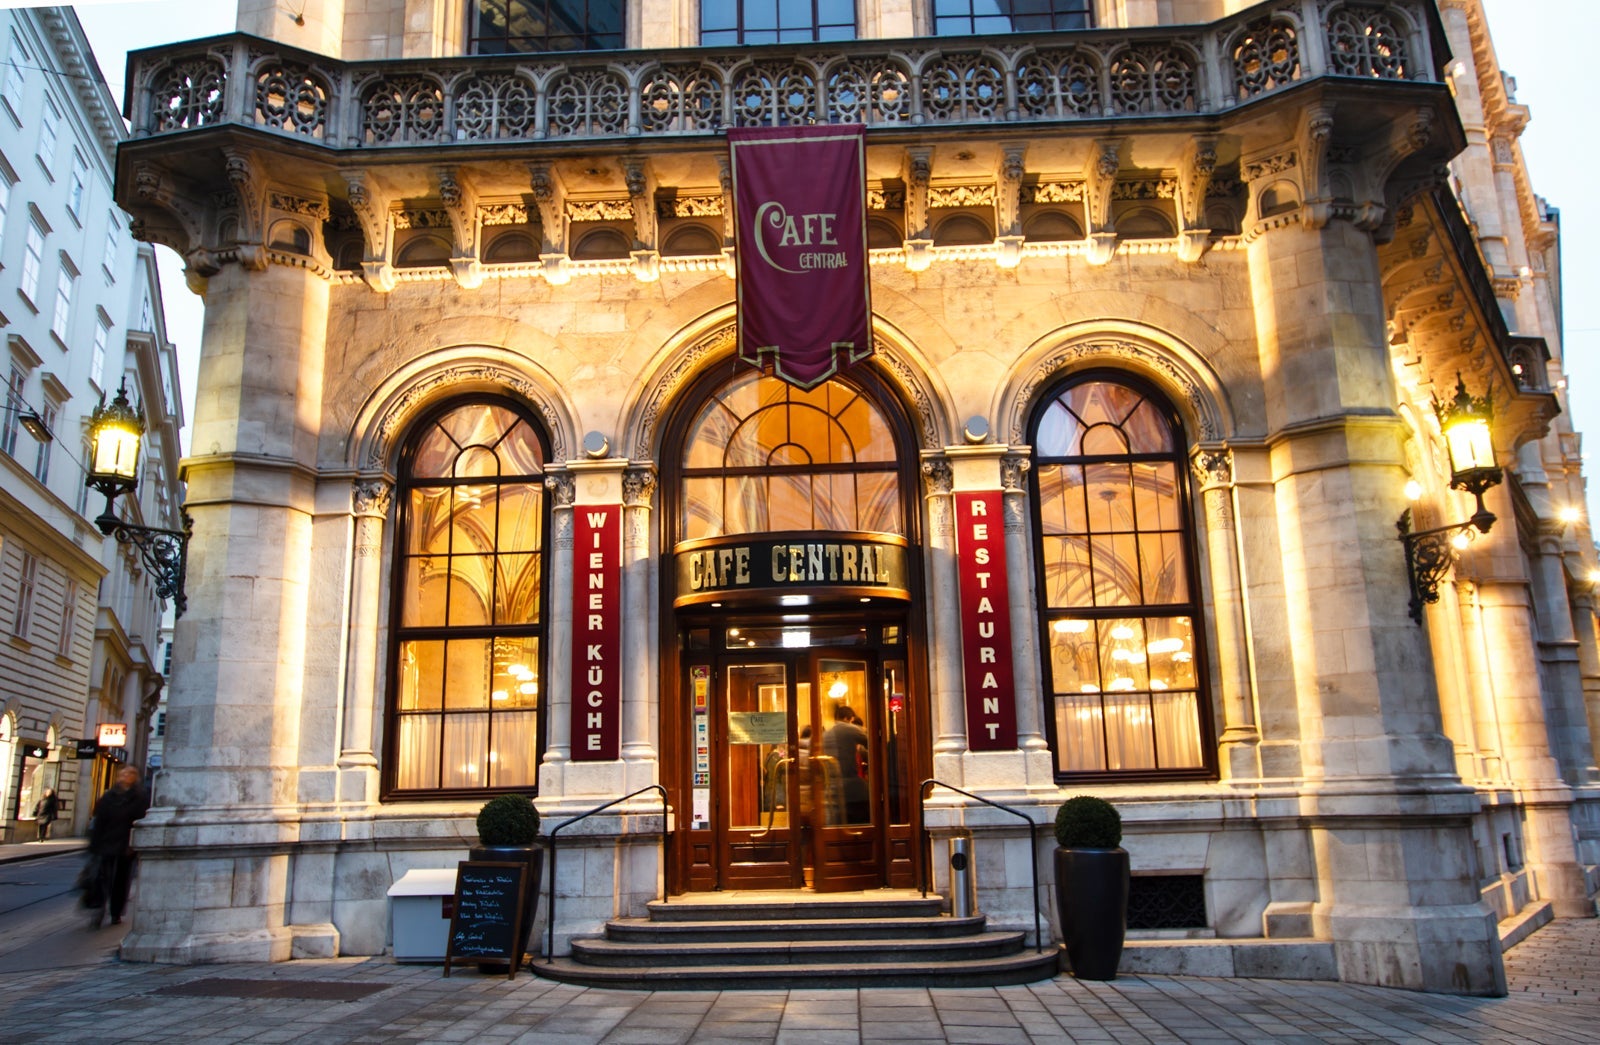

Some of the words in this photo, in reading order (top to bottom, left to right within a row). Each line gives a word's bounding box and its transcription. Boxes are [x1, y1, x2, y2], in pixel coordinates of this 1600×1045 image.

[754, 201, 838, 273] CAFE
[799, 252, 848, 269] CENTRAL
[587, 512, 607, 630] WIENER
[689, 547, 750, 590] CAFE
[771, 544, 890, 583] CENTRAL
[971, 500, 1000, 740] RESTAURANT
[587, 644, 603, 750] KÜCHE
